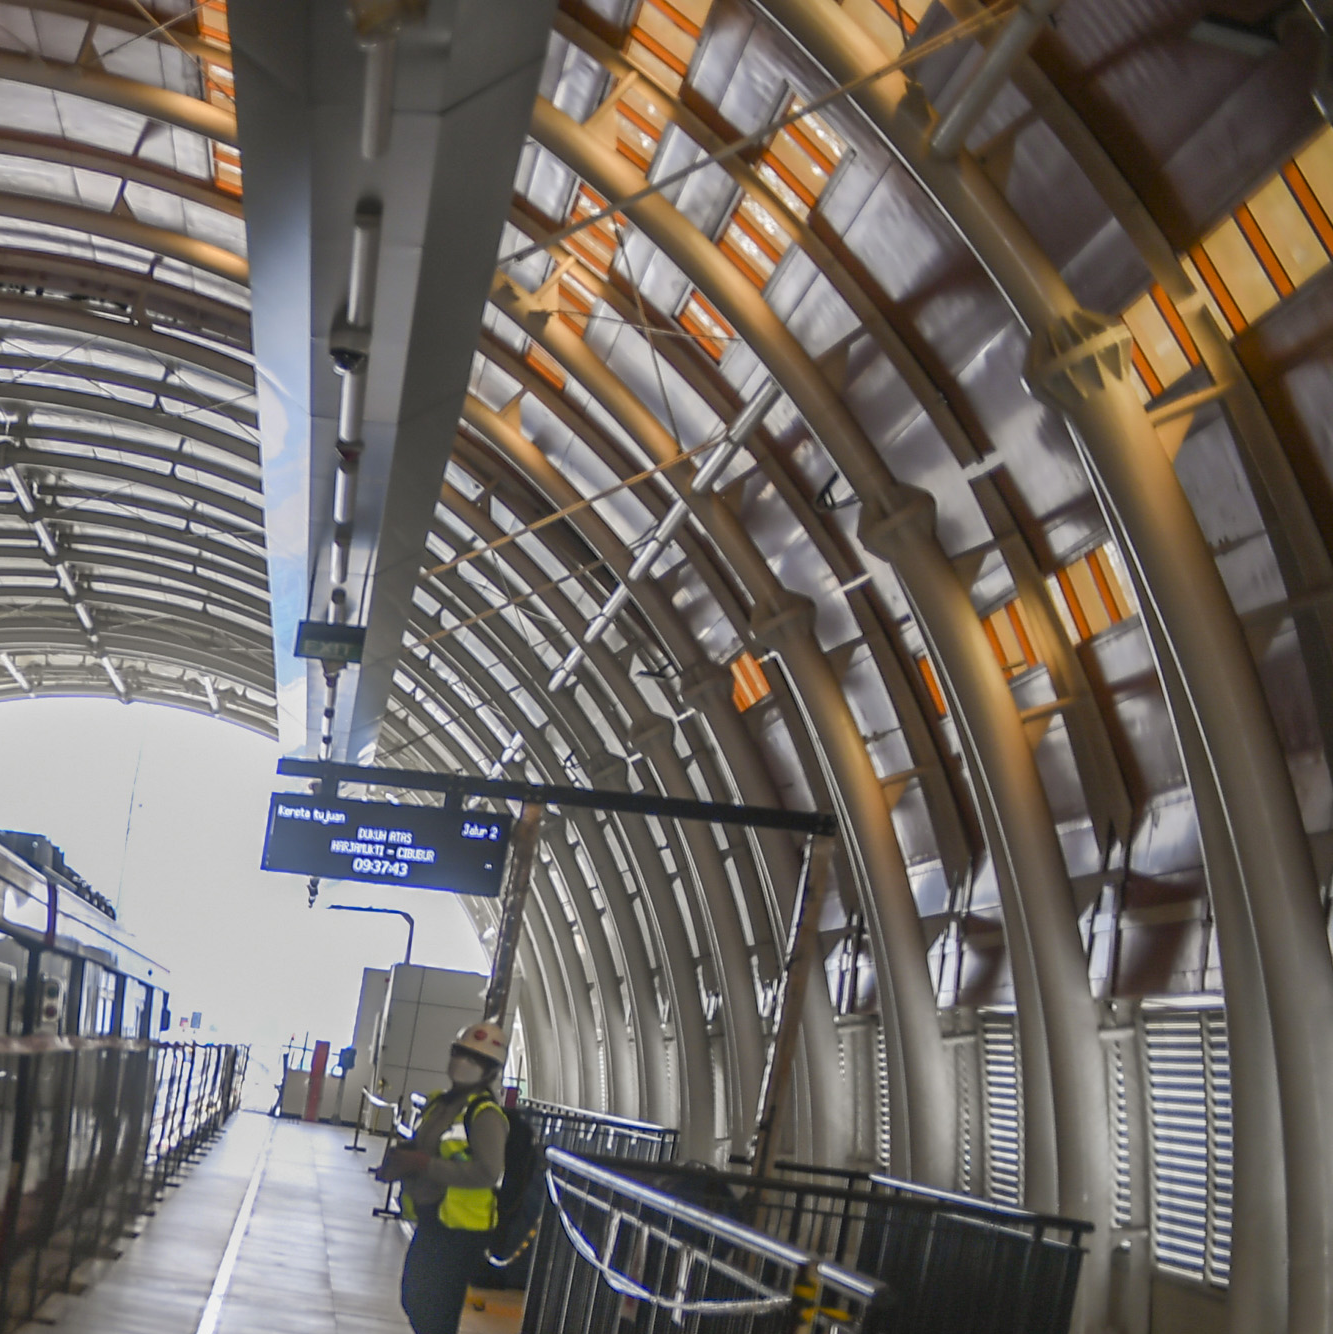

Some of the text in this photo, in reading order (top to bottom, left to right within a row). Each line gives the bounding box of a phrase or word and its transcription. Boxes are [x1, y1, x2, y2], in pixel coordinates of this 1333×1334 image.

[304, 639, 353, 657] EXIT
[277, 804, 346, 824] Kereta tujuan
[357, 827, 413, 844] DUKUH ATAS
[461, 823, 499, 840] Jalur 2
[330, 840, 384, 858] HARJAMUKTI
[396, 846, 436, 863] CIBUBUR
[352, 857, 409, 877] 09:37:43
